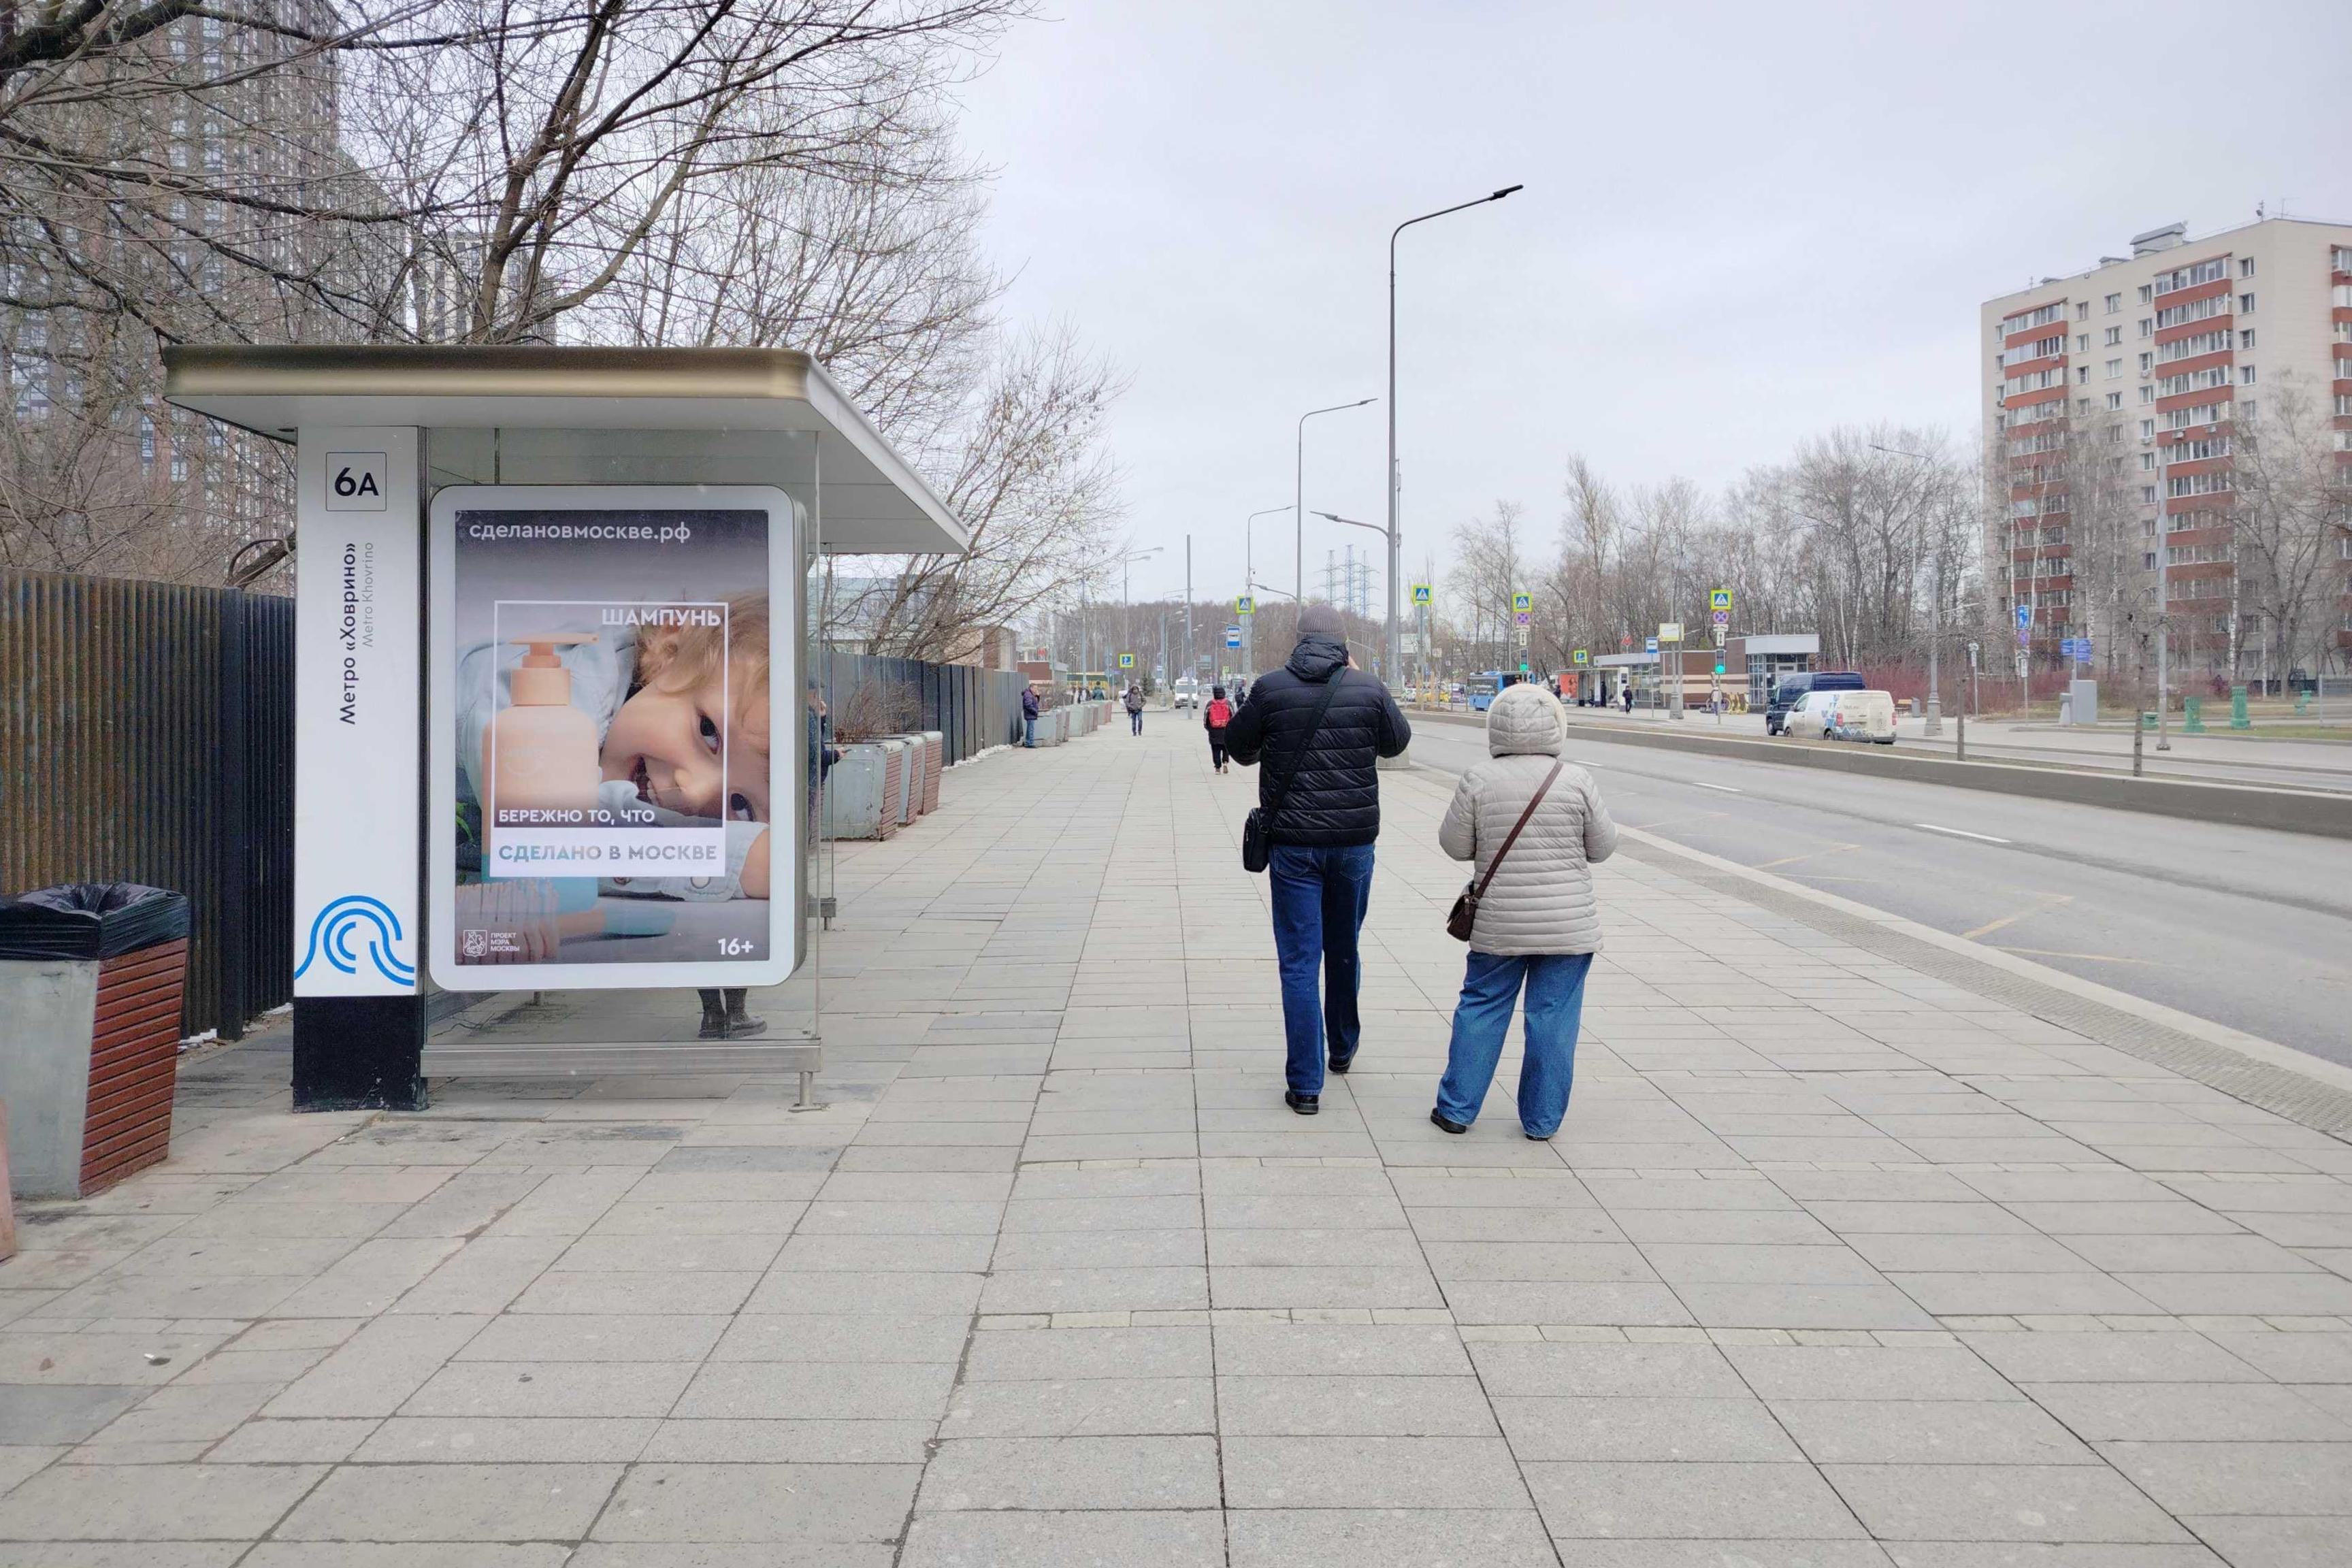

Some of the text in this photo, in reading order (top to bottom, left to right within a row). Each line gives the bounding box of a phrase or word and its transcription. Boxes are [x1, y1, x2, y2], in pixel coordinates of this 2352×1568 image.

[469, 521, 691, 543] сделановмоскве.рф
[363, 542, 373, 647] Metro Khovrino
[602, 608, 721, 626] ШАМПУНЬ
[340, 542, 359, 725] Метро «Ховрино»
[498, 809, 655, 826] БЕРЕЖНО ТО, ЧТО
[498, 845, 717, 862] СДЕЛАНО В МОСКВЕ
[718, 938, 753, 956] 16+
